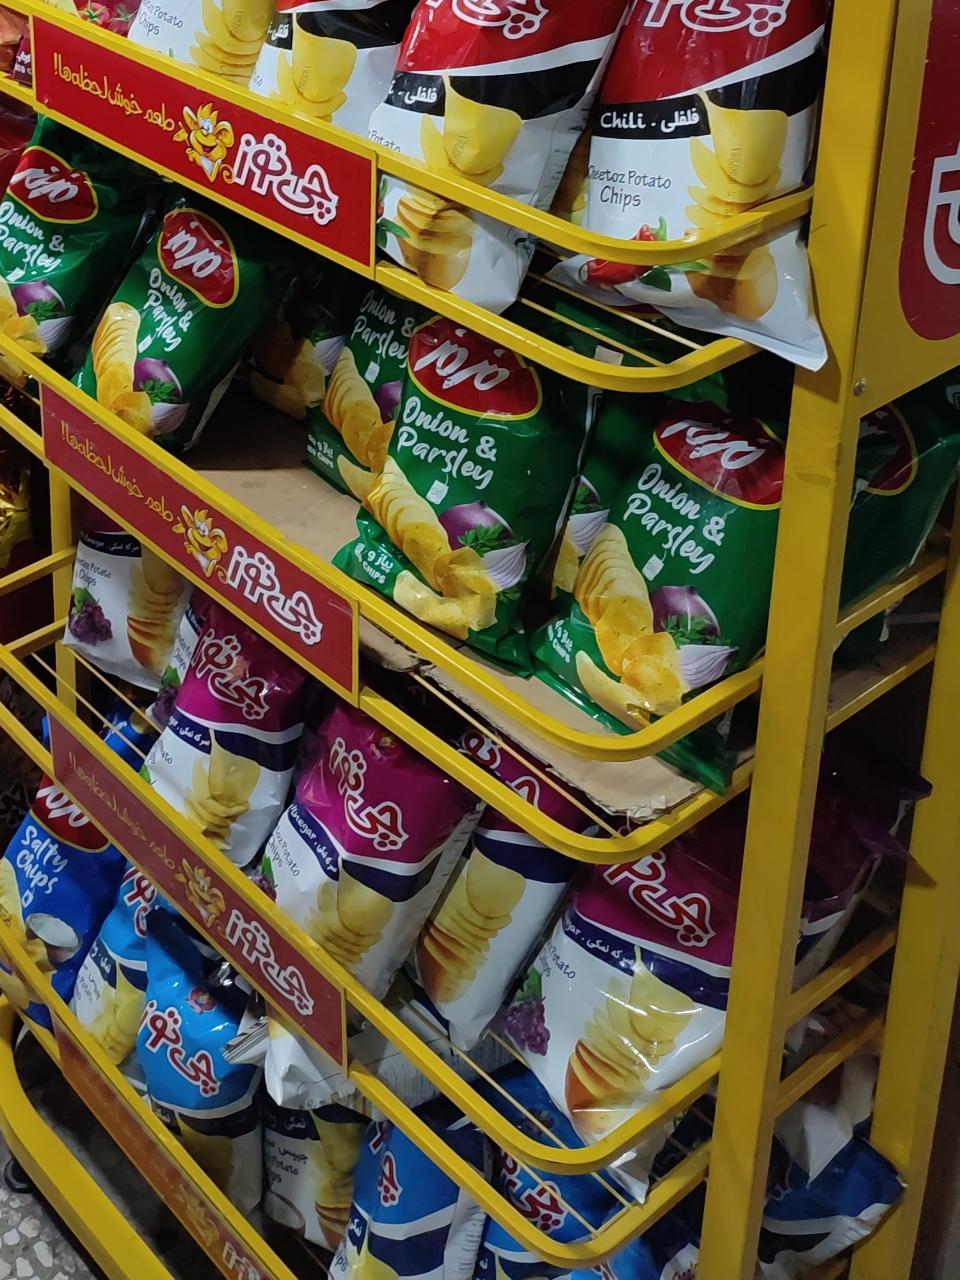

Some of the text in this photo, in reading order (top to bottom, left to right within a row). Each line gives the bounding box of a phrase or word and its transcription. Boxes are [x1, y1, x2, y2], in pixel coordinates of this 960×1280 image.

[108, 84, 144, 116] خوش
[143, 102, 175, 132] طعم
[599, 106, 700, 134] Chili فلفلی
[599, 184, 642, 213] Chips
[628, 169, 672, 190] Potato
[49, 234, 65, 253] &
[148, 266, 188, 316] Onion
[359, 289, 397, 325] Onion
[143, 288, 183, 352] Parsley
[351, 315, 408, 369] Parsley
[402, 394, 498, 462] Onion &
[396, 425, 494, 491] Parsley
[637, 461, 725, 547] Onion &
[622, 492, 716, 575] Parsley
[21, 825, 68, 873] Salty
[17, 851, 59, 895] Chips
